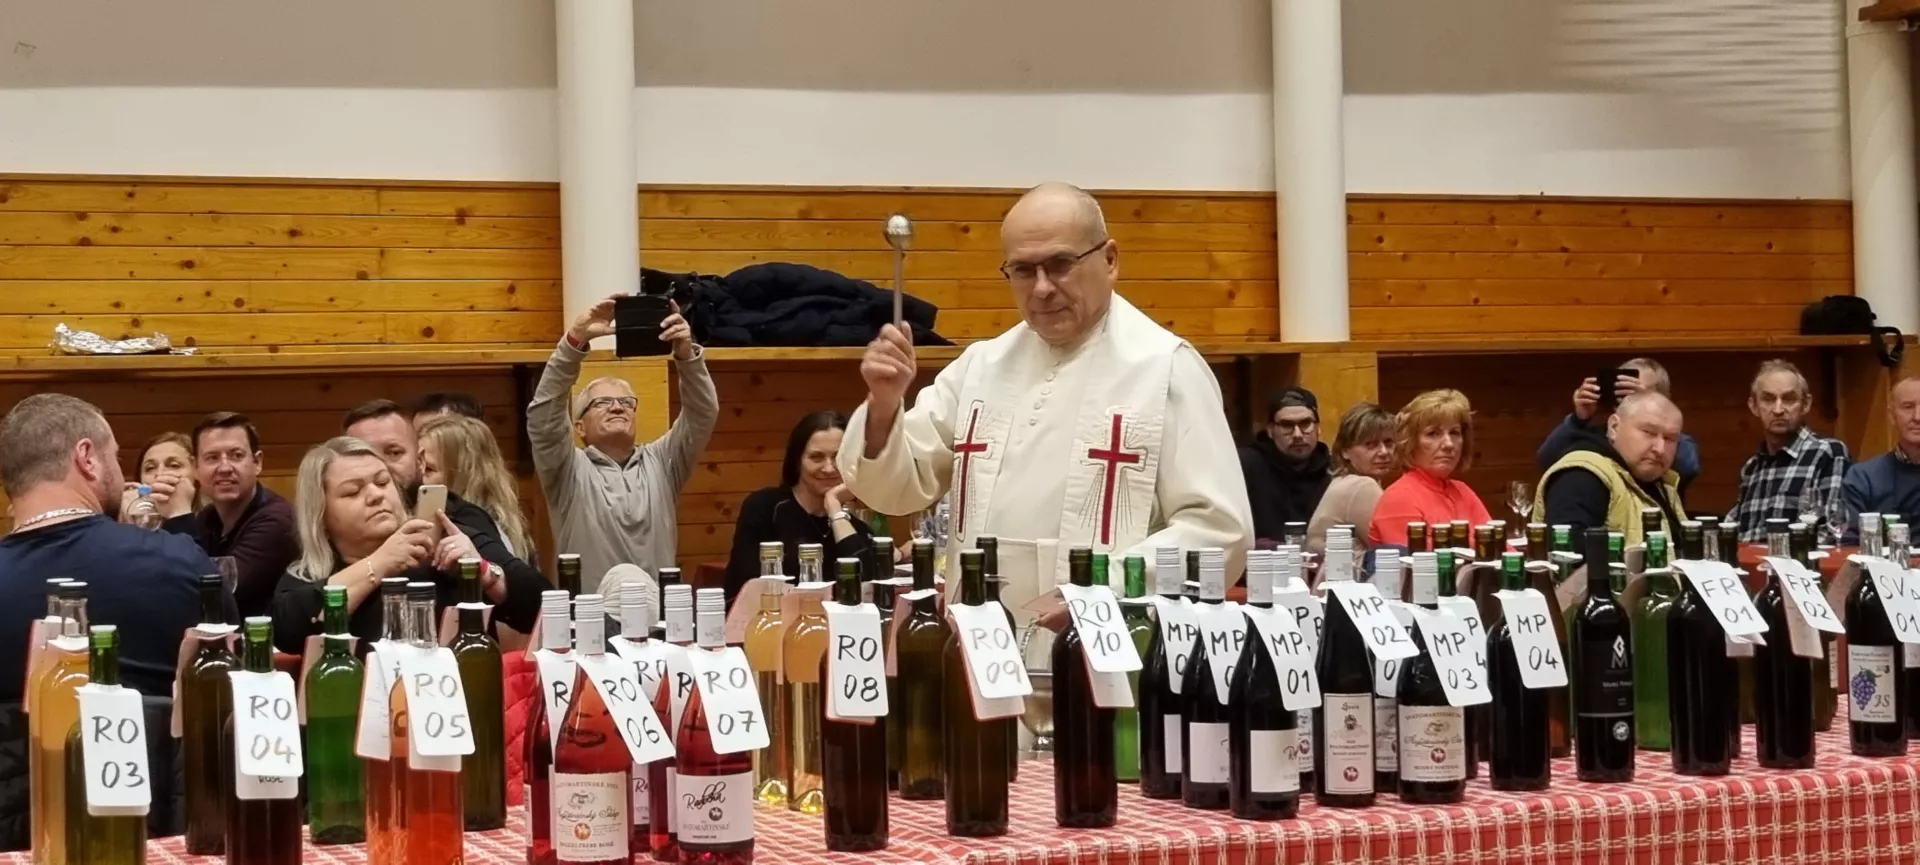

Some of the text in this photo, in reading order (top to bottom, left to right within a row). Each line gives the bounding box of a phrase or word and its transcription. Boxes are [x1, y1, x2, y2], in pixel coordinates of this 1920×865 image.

[1700, 577, 1742, 598] FR
[1784, 572, 1816, 595] FR
[1880, 575, 1904, 599] SV
[1068, 598, 1112, 628] RO
[1349, 596, 1384, 618] MP
[1724, 605, 1755, 624] 01
[1802, 600, 1833, 621] 02
[1168, 622, 1197, 642] MP
[1372, 625, 1408, 646] 02
[1516, 614, 1547, 634] MP
[1896, 612, 1920, 635] 01
[837, 634, 879, 662] RO
[970, 627, 1010, 652] RO
[1092, 630, 1121, 657] 10
[1210, 630, 1245, 655] MP
[1270, 631, 1304, 656] MP
[1432, 632, 1466, 657] MP
[1528, 646, 1559, 671] 04
[702, 667, 747, 694] RO
[986, 660, 1023, 684] 09
[1287, 668, 1310, 694] 01
[1447, 668, 1478, 690] 03
[414, 672, 458, 698] RO
[602, 677, 637, 706] RO
[844, 674, 880, 702] 08
[248, 694, 292, 720] RO
[91, 715, 139, 744] RO
[424, 711, 467, 738] 05
[626, 715, 660, 748] 06
[717, 709, 759, 736] 07
[250, 733, 297, 764] 04
[101, 760, 145, 789] 03
